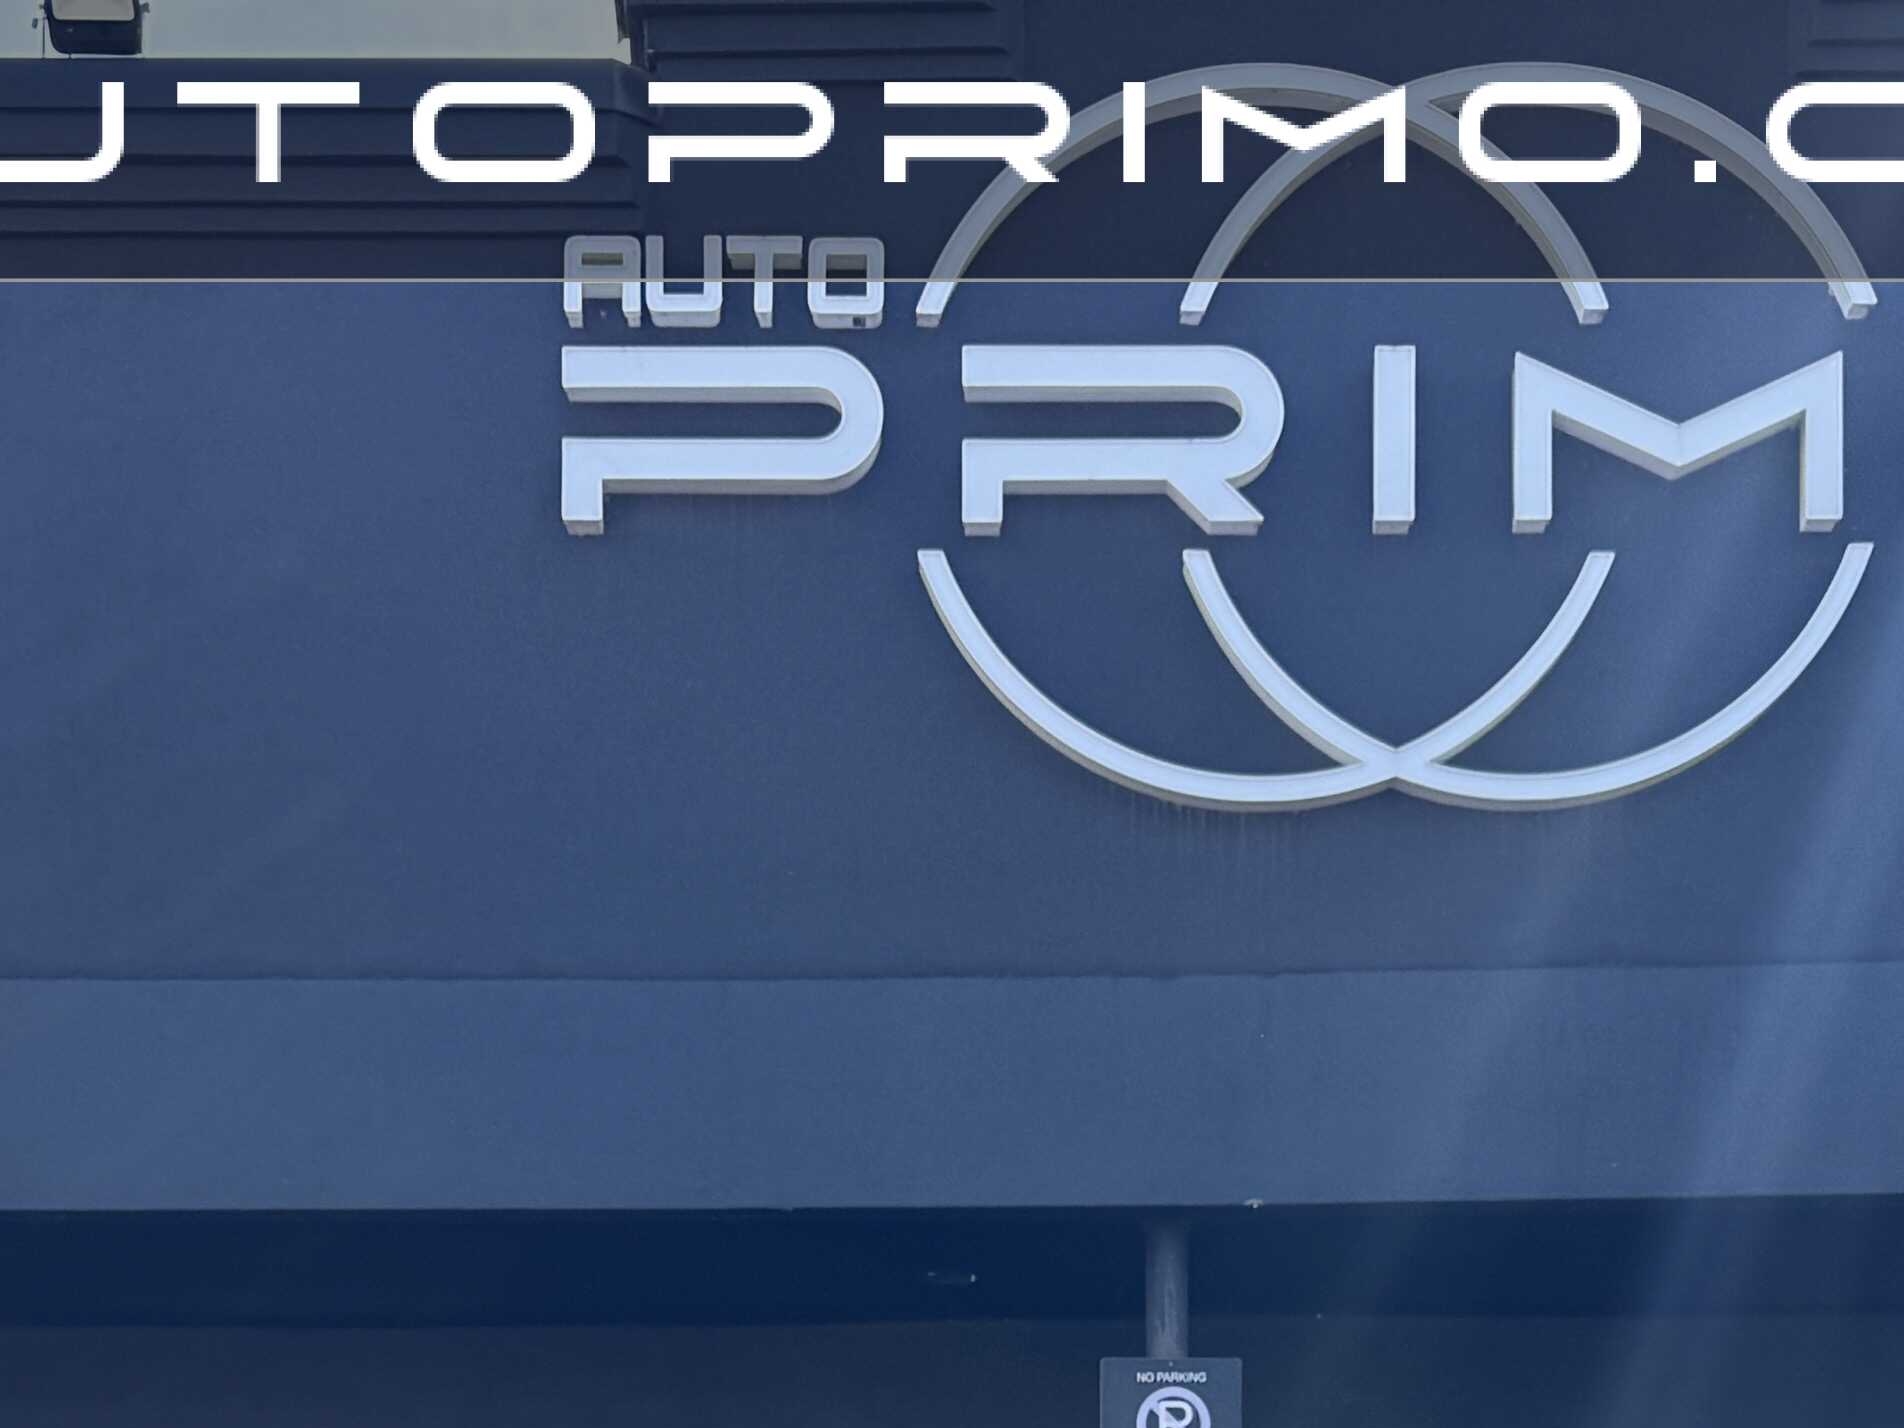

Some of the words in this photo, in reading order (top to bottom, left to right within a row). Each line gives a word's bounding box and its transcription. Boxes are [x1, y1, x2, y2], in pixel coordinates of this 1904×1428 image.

[563, 235, 885, 329] AUTO
[1136, 1371, 1155, 1383] NO
[1156, 1371, 1207, 1383] PARKING
